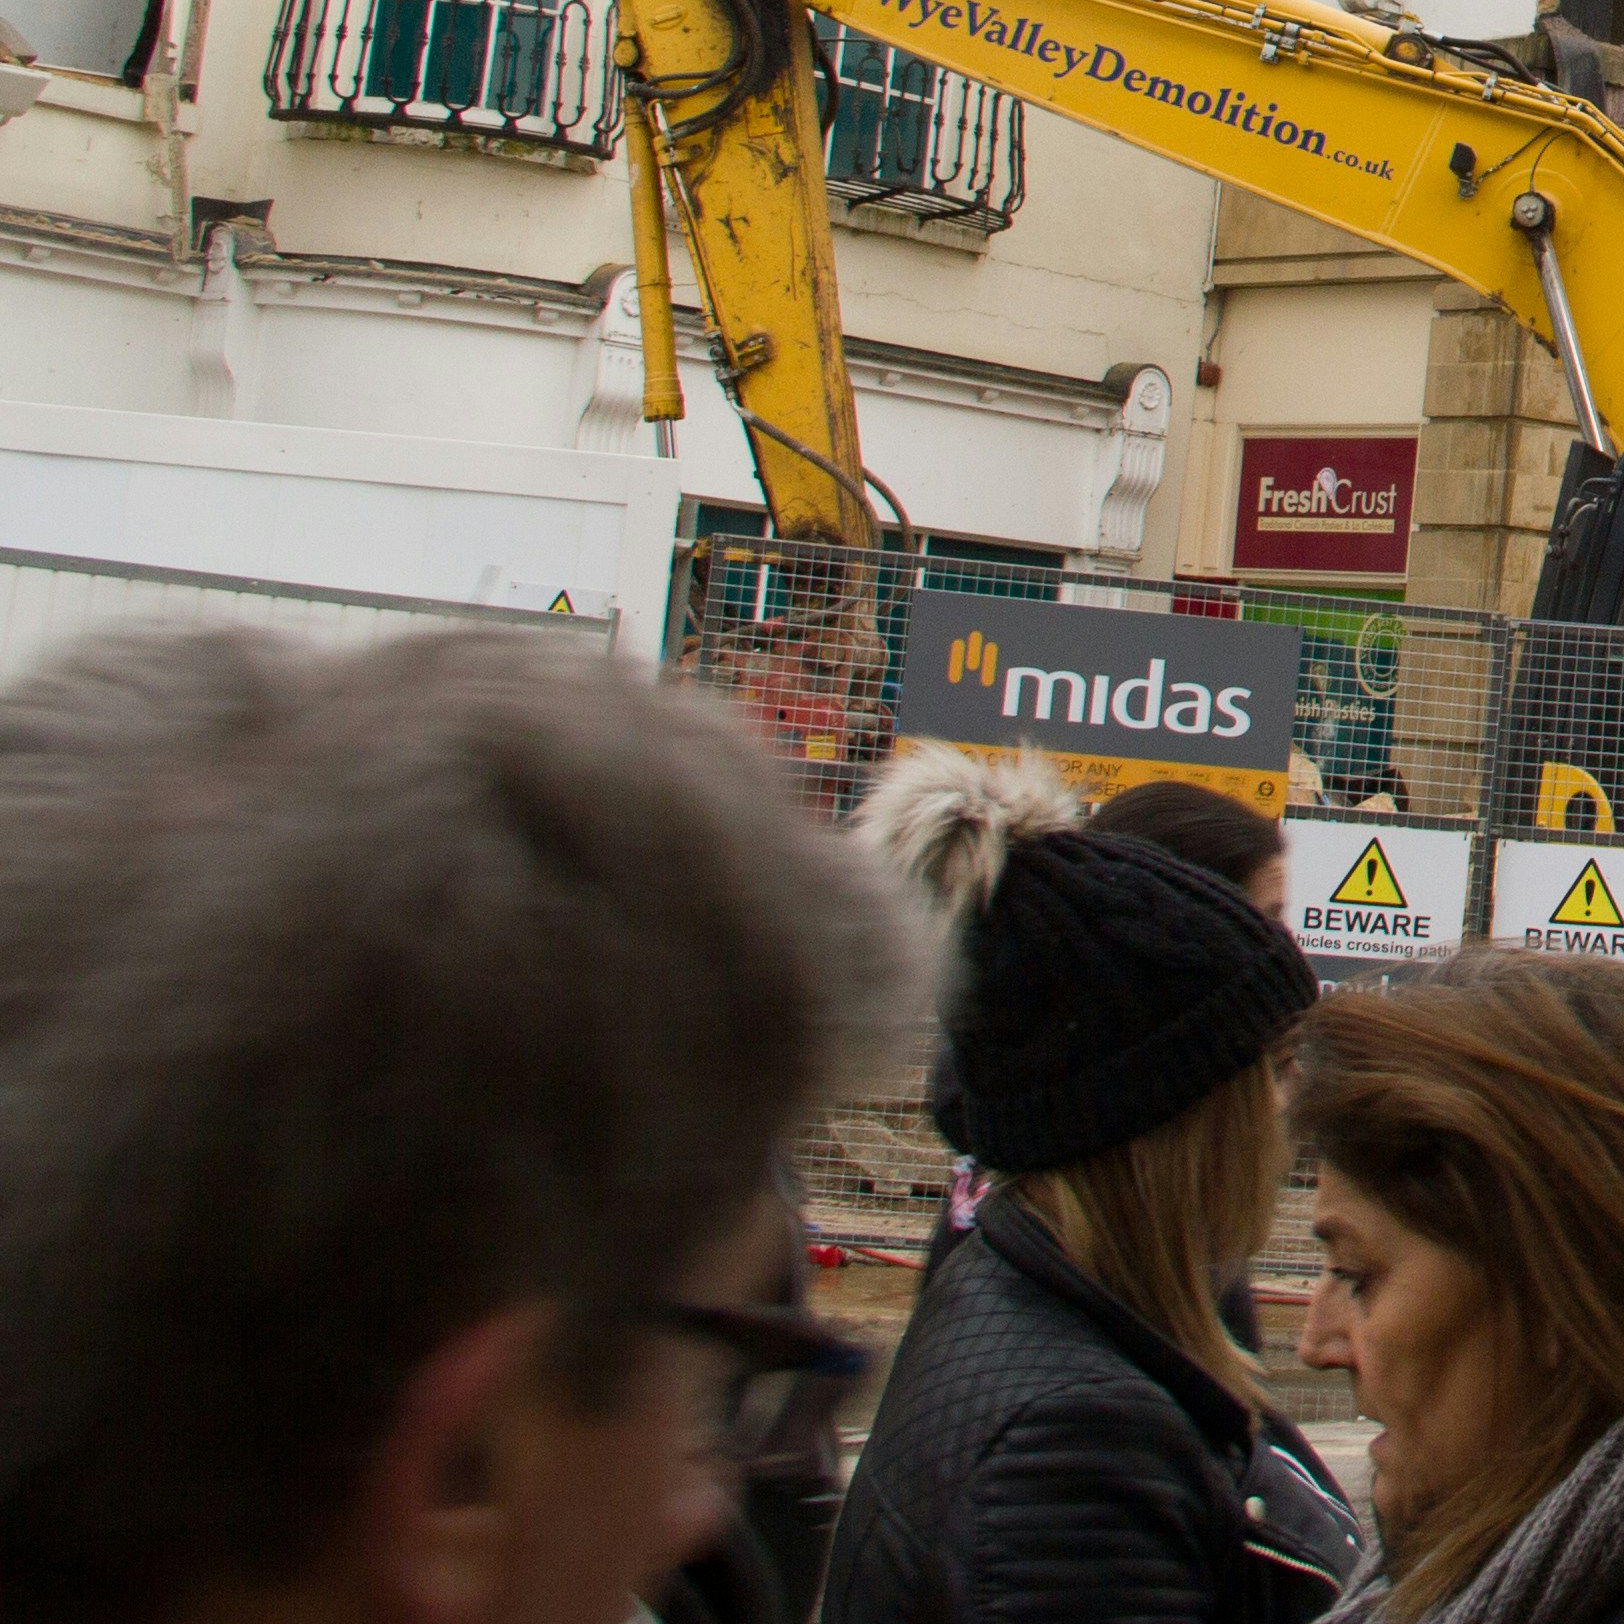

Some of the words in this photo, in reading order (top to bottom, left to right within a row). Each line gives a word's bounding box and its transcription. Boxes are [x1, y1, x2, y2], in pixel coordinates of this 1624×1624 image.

[1003, 658, 1253, 738] midas
[1087, 762, 1123, 777] ANY
[1303, 906, 1431, 938] BEWARE
[1296, 934, 1341, 950] hicles
[1346, 940, 1414, 958] crossing
